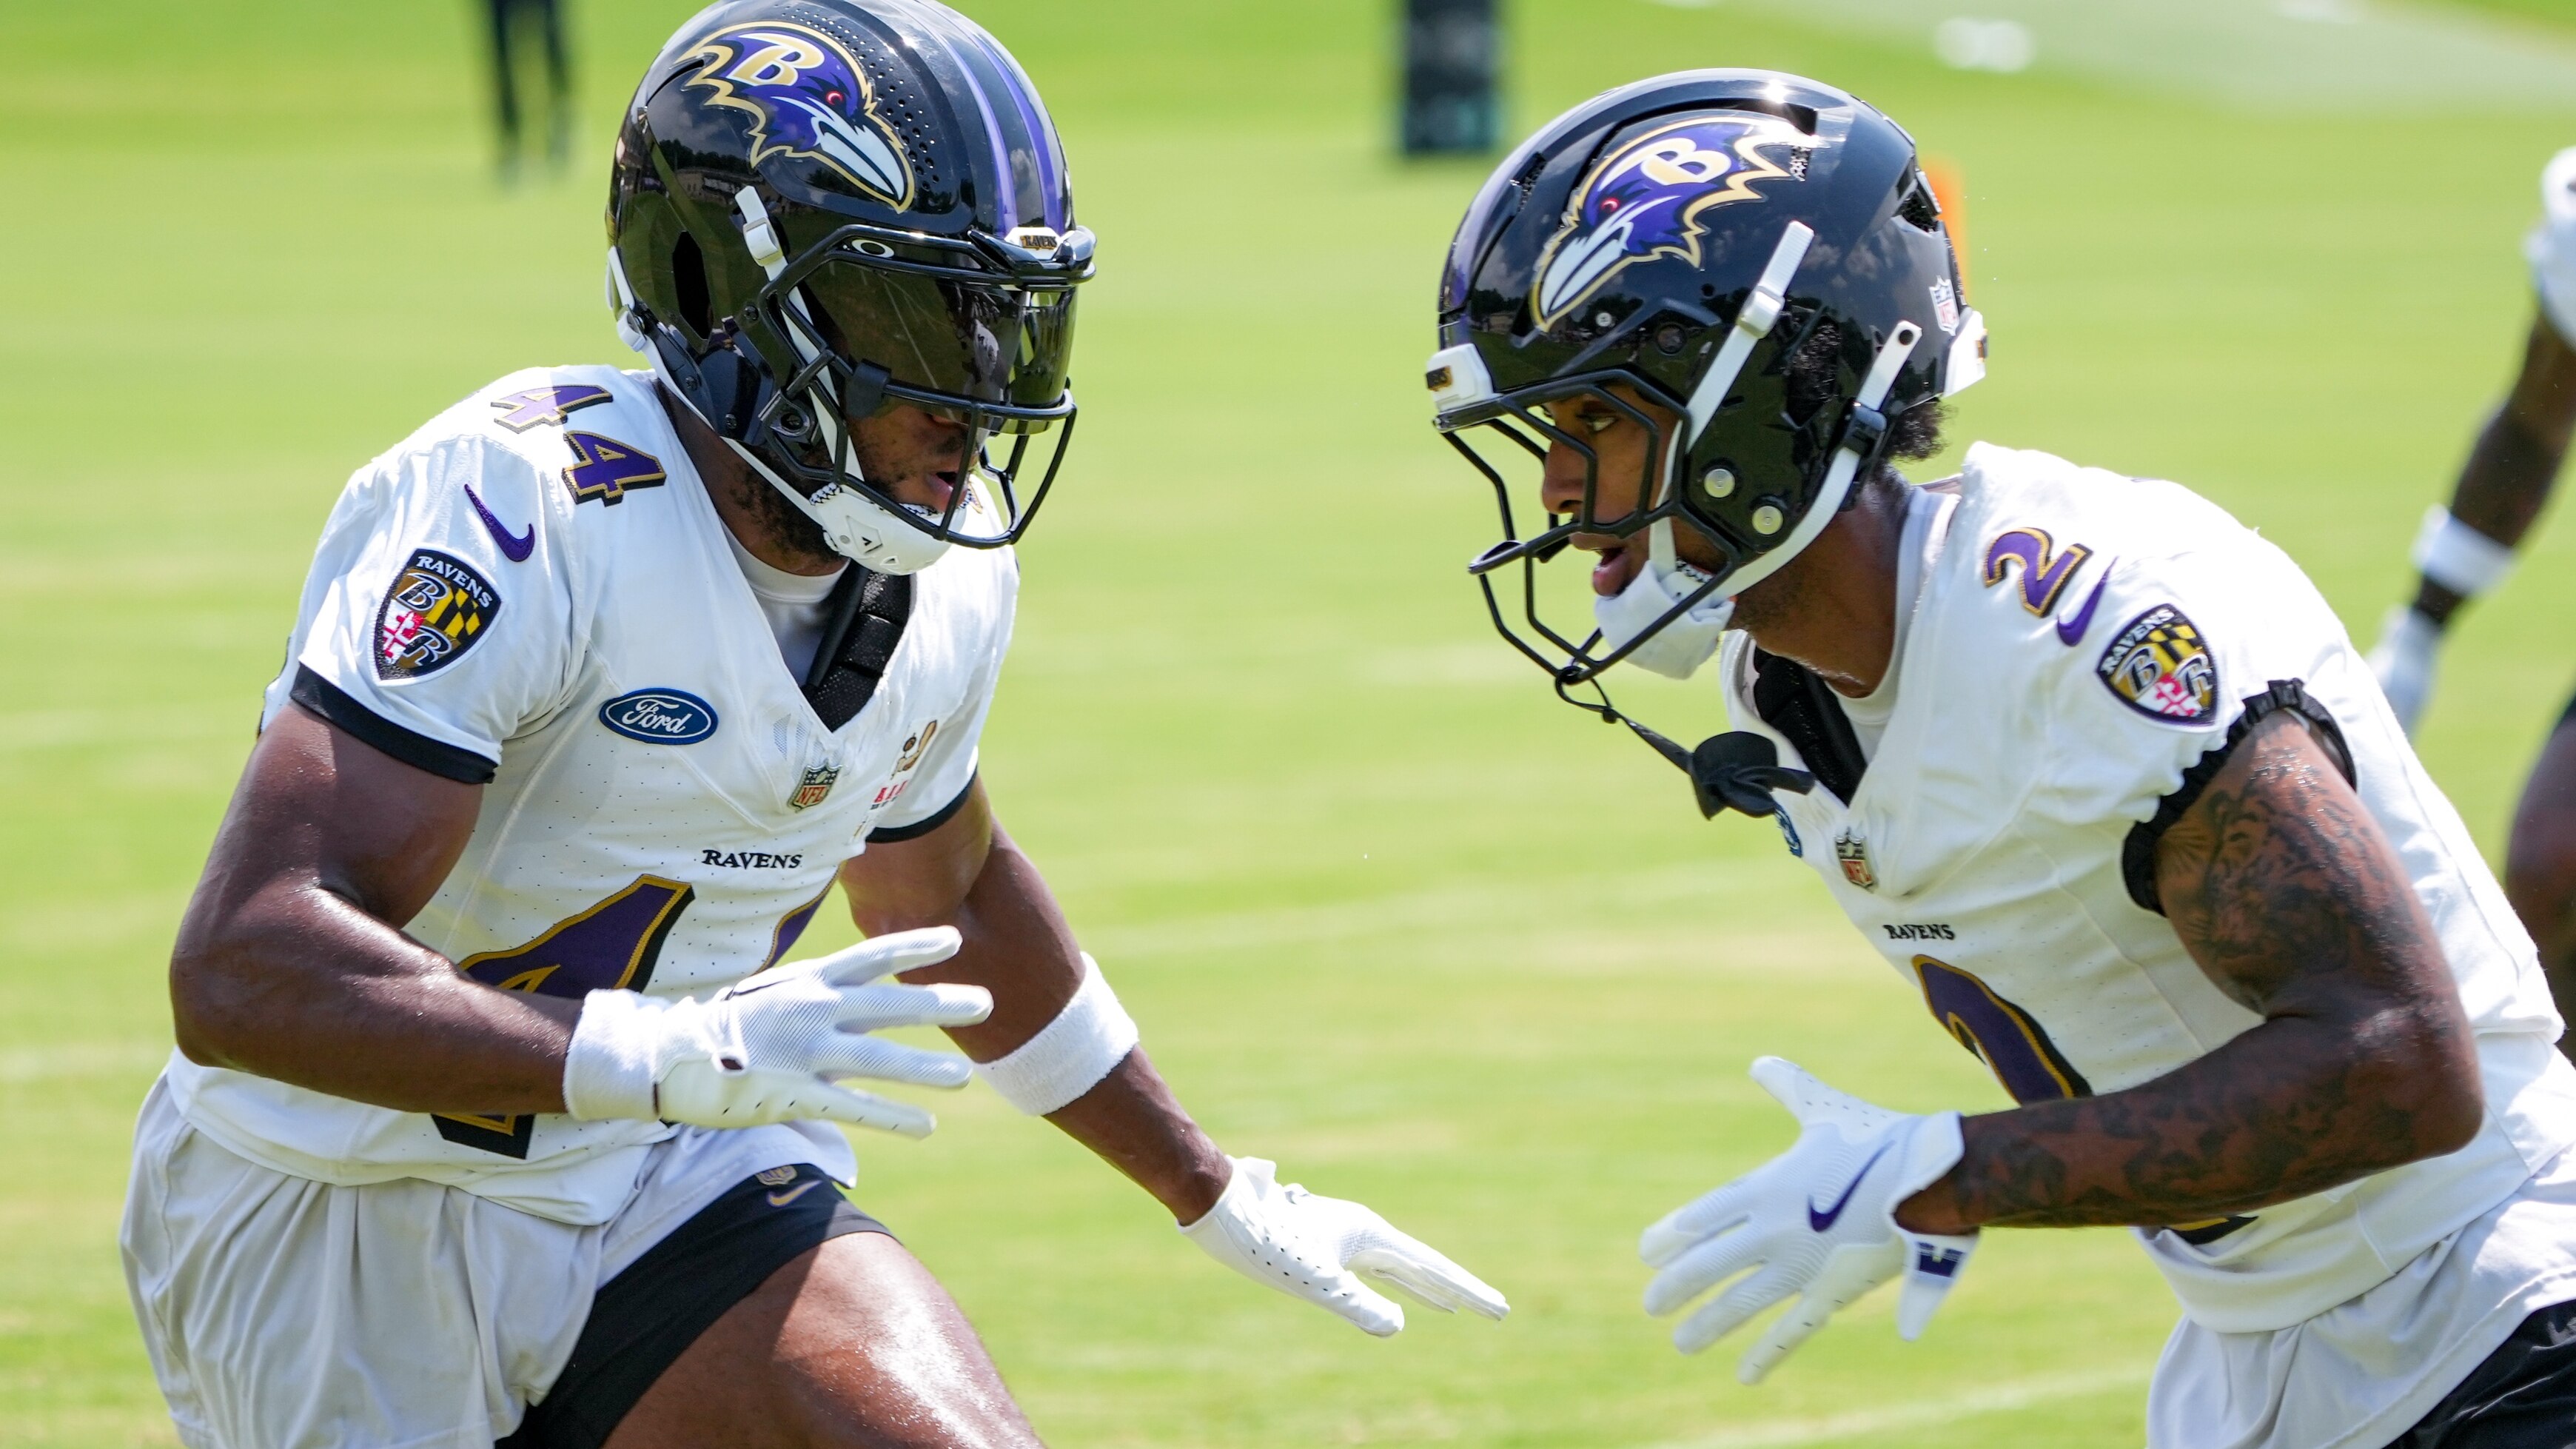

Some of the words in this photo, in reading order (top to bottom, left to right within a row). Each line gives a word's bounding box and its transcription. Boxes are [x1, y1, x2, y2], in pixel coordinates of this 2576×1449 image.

[416, 555, 493, 608] RAVENS
[1982, 526, 2094, 618] 2
[622, 698, 693, 734] Ford
[794, 786, 828, 806] NFL
[701, 849, 802, 870] RAVENS
[1882, 923, 1955, 941] RAVENS
